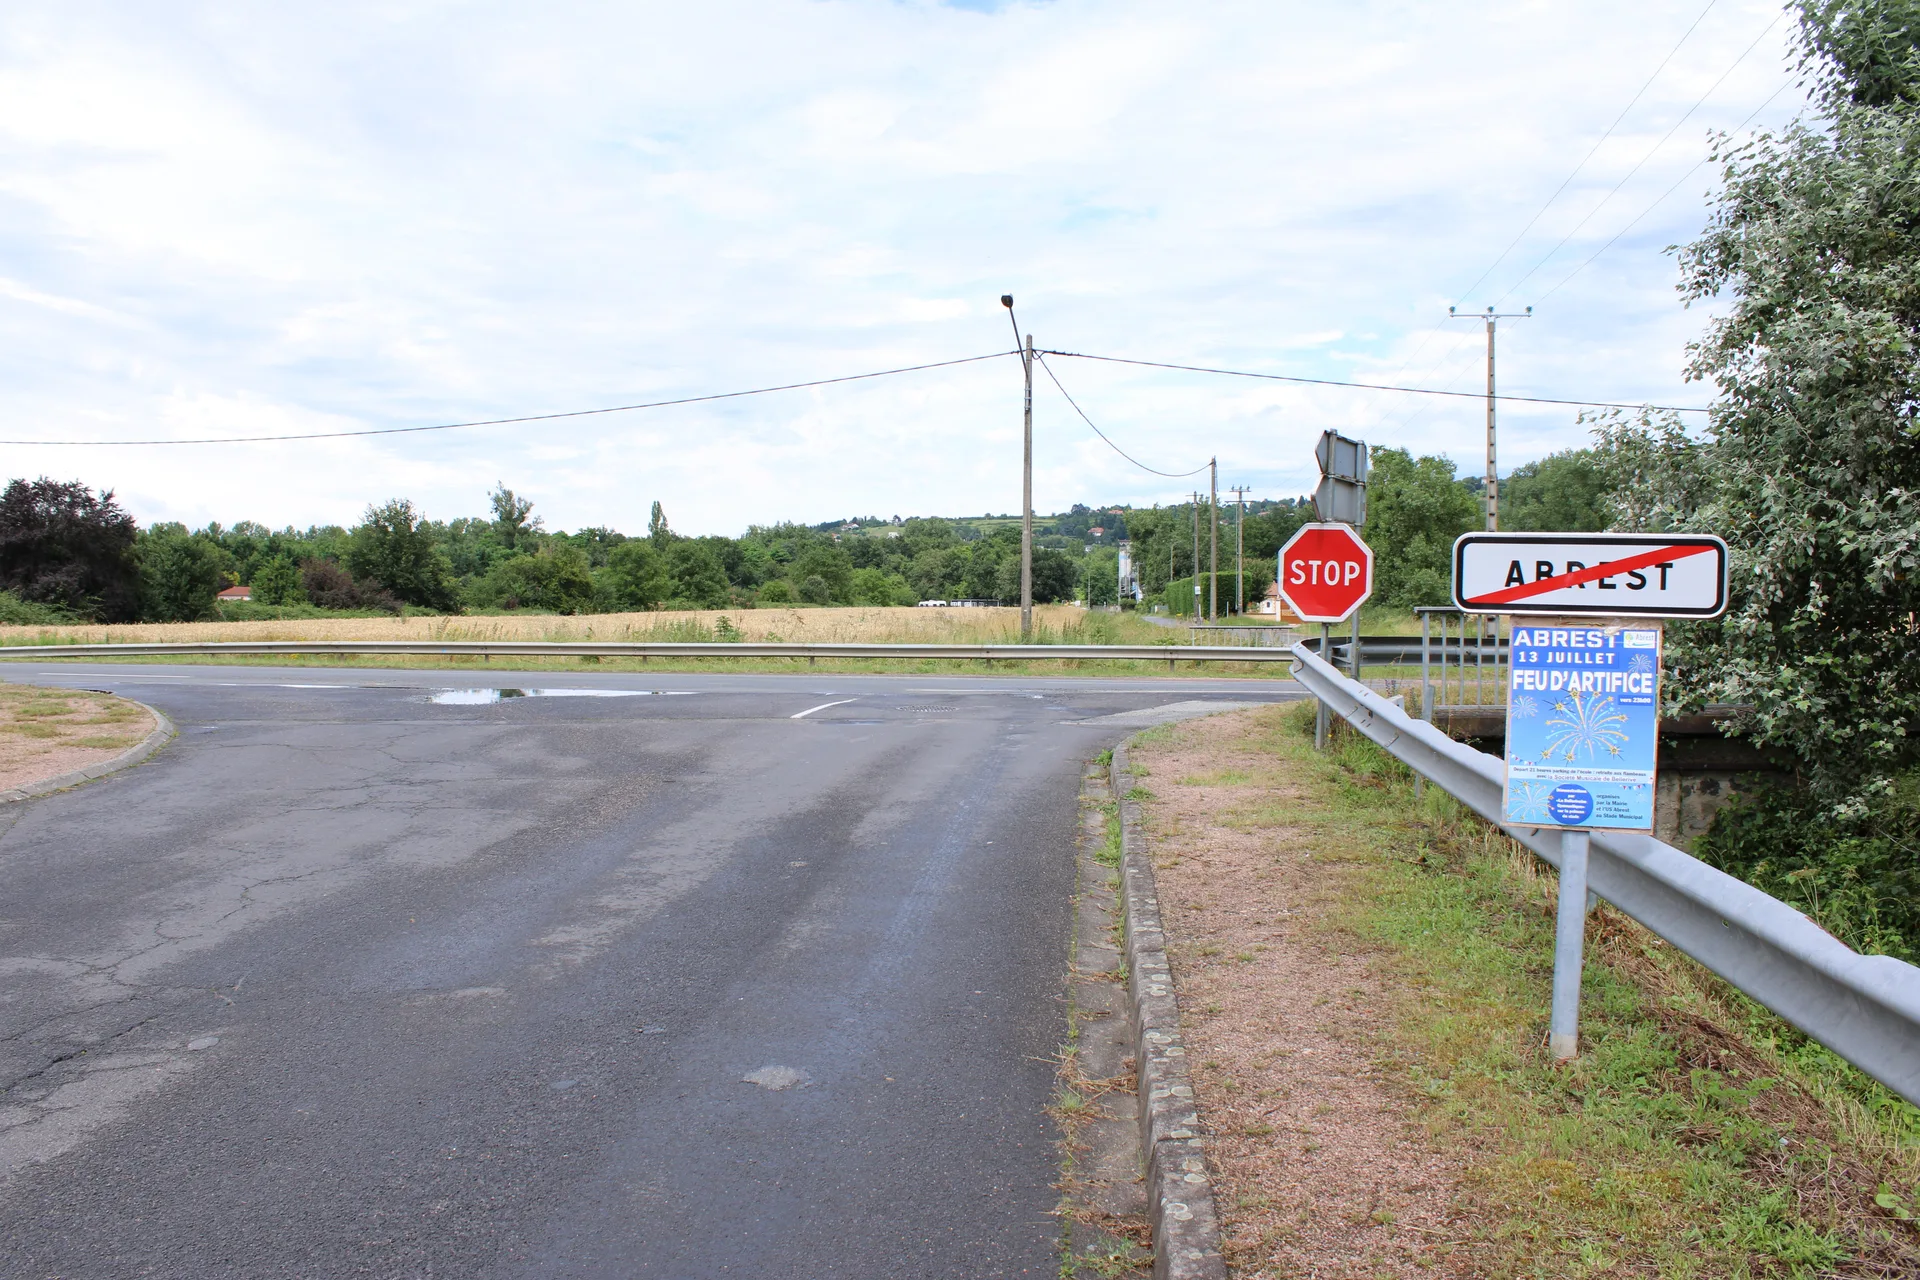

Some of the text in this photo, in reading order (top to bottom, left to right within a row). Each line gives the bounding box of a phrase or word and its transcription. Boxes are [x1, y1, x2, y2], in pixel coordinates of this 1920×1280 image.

[1290, 559, 1360, 586] STOP
[1513, 629, 1619, 648] ABREST
[1518, 651, 1616, 665] 13 JUILLET
